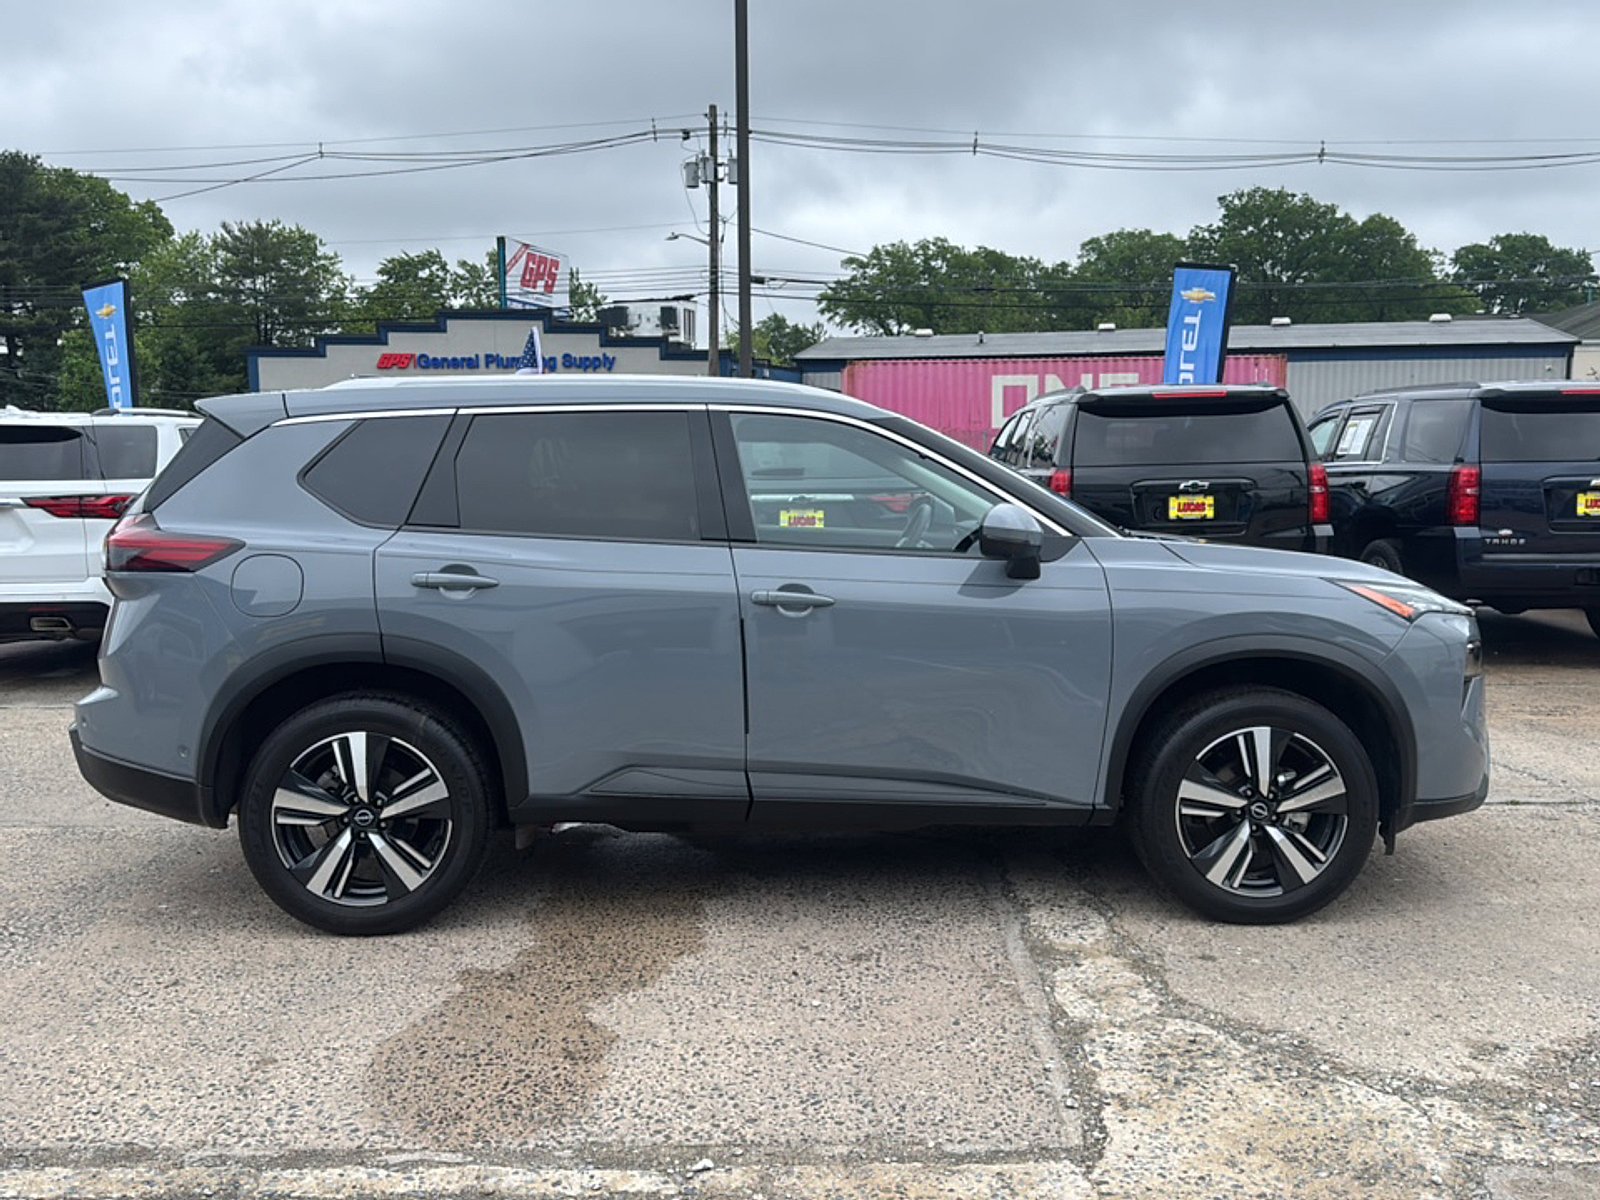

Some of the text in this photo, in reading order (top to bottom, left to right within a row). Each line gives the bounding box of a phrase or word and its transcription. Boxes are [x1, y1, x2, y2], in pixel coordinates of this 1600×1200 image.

[520, 251, 561, 294] GPS
[377, 353, 413, 369] GPS
[418, 353, 479, 369] General
[562, 353, 616, 372] Supply
[1177, 501, 1206, 512] LUCAS
